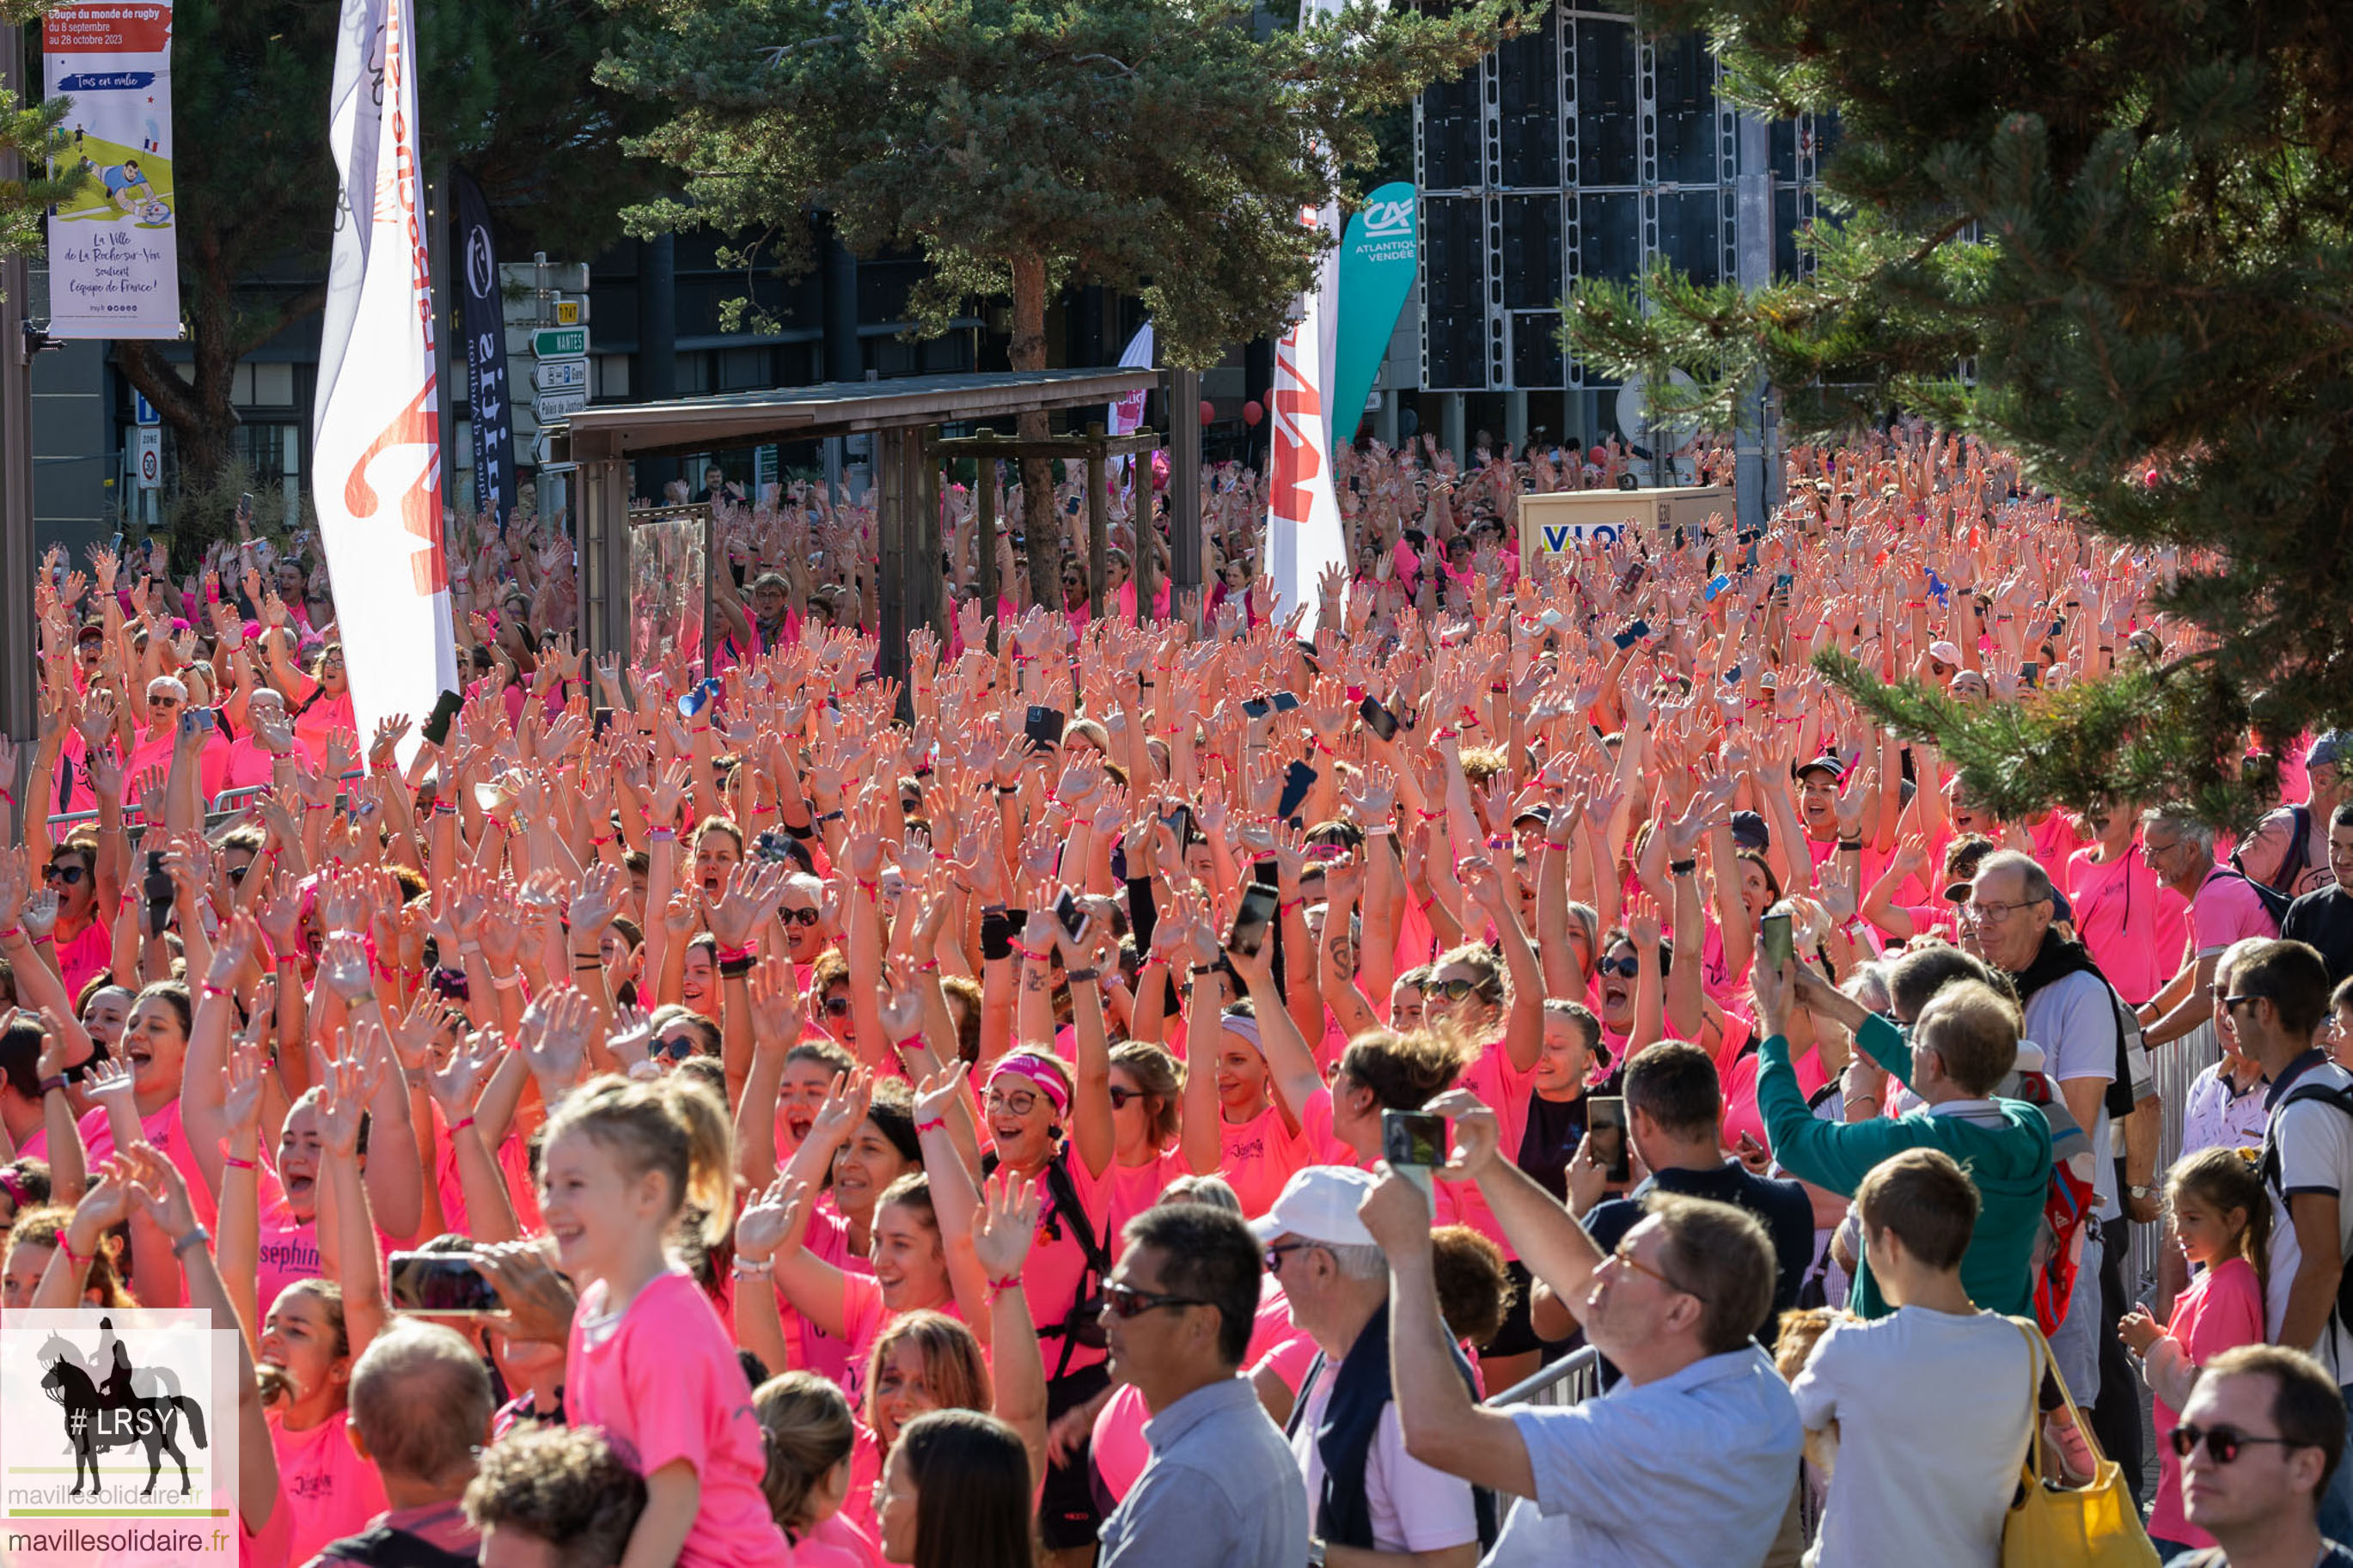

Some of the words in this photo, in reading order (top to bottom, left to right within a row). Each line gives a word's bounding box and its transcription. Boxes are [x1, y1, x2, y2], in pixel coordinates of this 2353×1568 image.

[48, 9, 76, 21] Coupe
[78, 9, 89, 19] du
[91, 9, 121, 19] monde
[122, 9, 133, 19] de
[134, 9, 160, 21] rugby
[49, 23, 60, 33] du
[61, 23, 67, 32] 8
[69, 22, 110, 35] septembre
[49, 36, 60, 45] au
[73, 35, 103, 45] octobre
[105, 35, 123, 45] 2023
[75, 74, 95, 88] Tous
[99, 77, 111, 86] en
[114, 72, 138, 86] ovalie
[94, 233, 104, 247] La
[109, 231, 131, 247] Ville
[1355, 241, 1416, 254] ATLANTIQU
[64, 248, 76, 260] de
[79, 249, 90, 263] La
[1367, 249, 1415, 262] VENDÉE
[95, 267, 130, 278] soutient
[106, 279, 119, 293] de
[557, 333, 583, 351] NANTES
[571, 367, 584, 381] Gare
[541, 402, 557, 415] Palais
[558, 401, 564, 413] de
